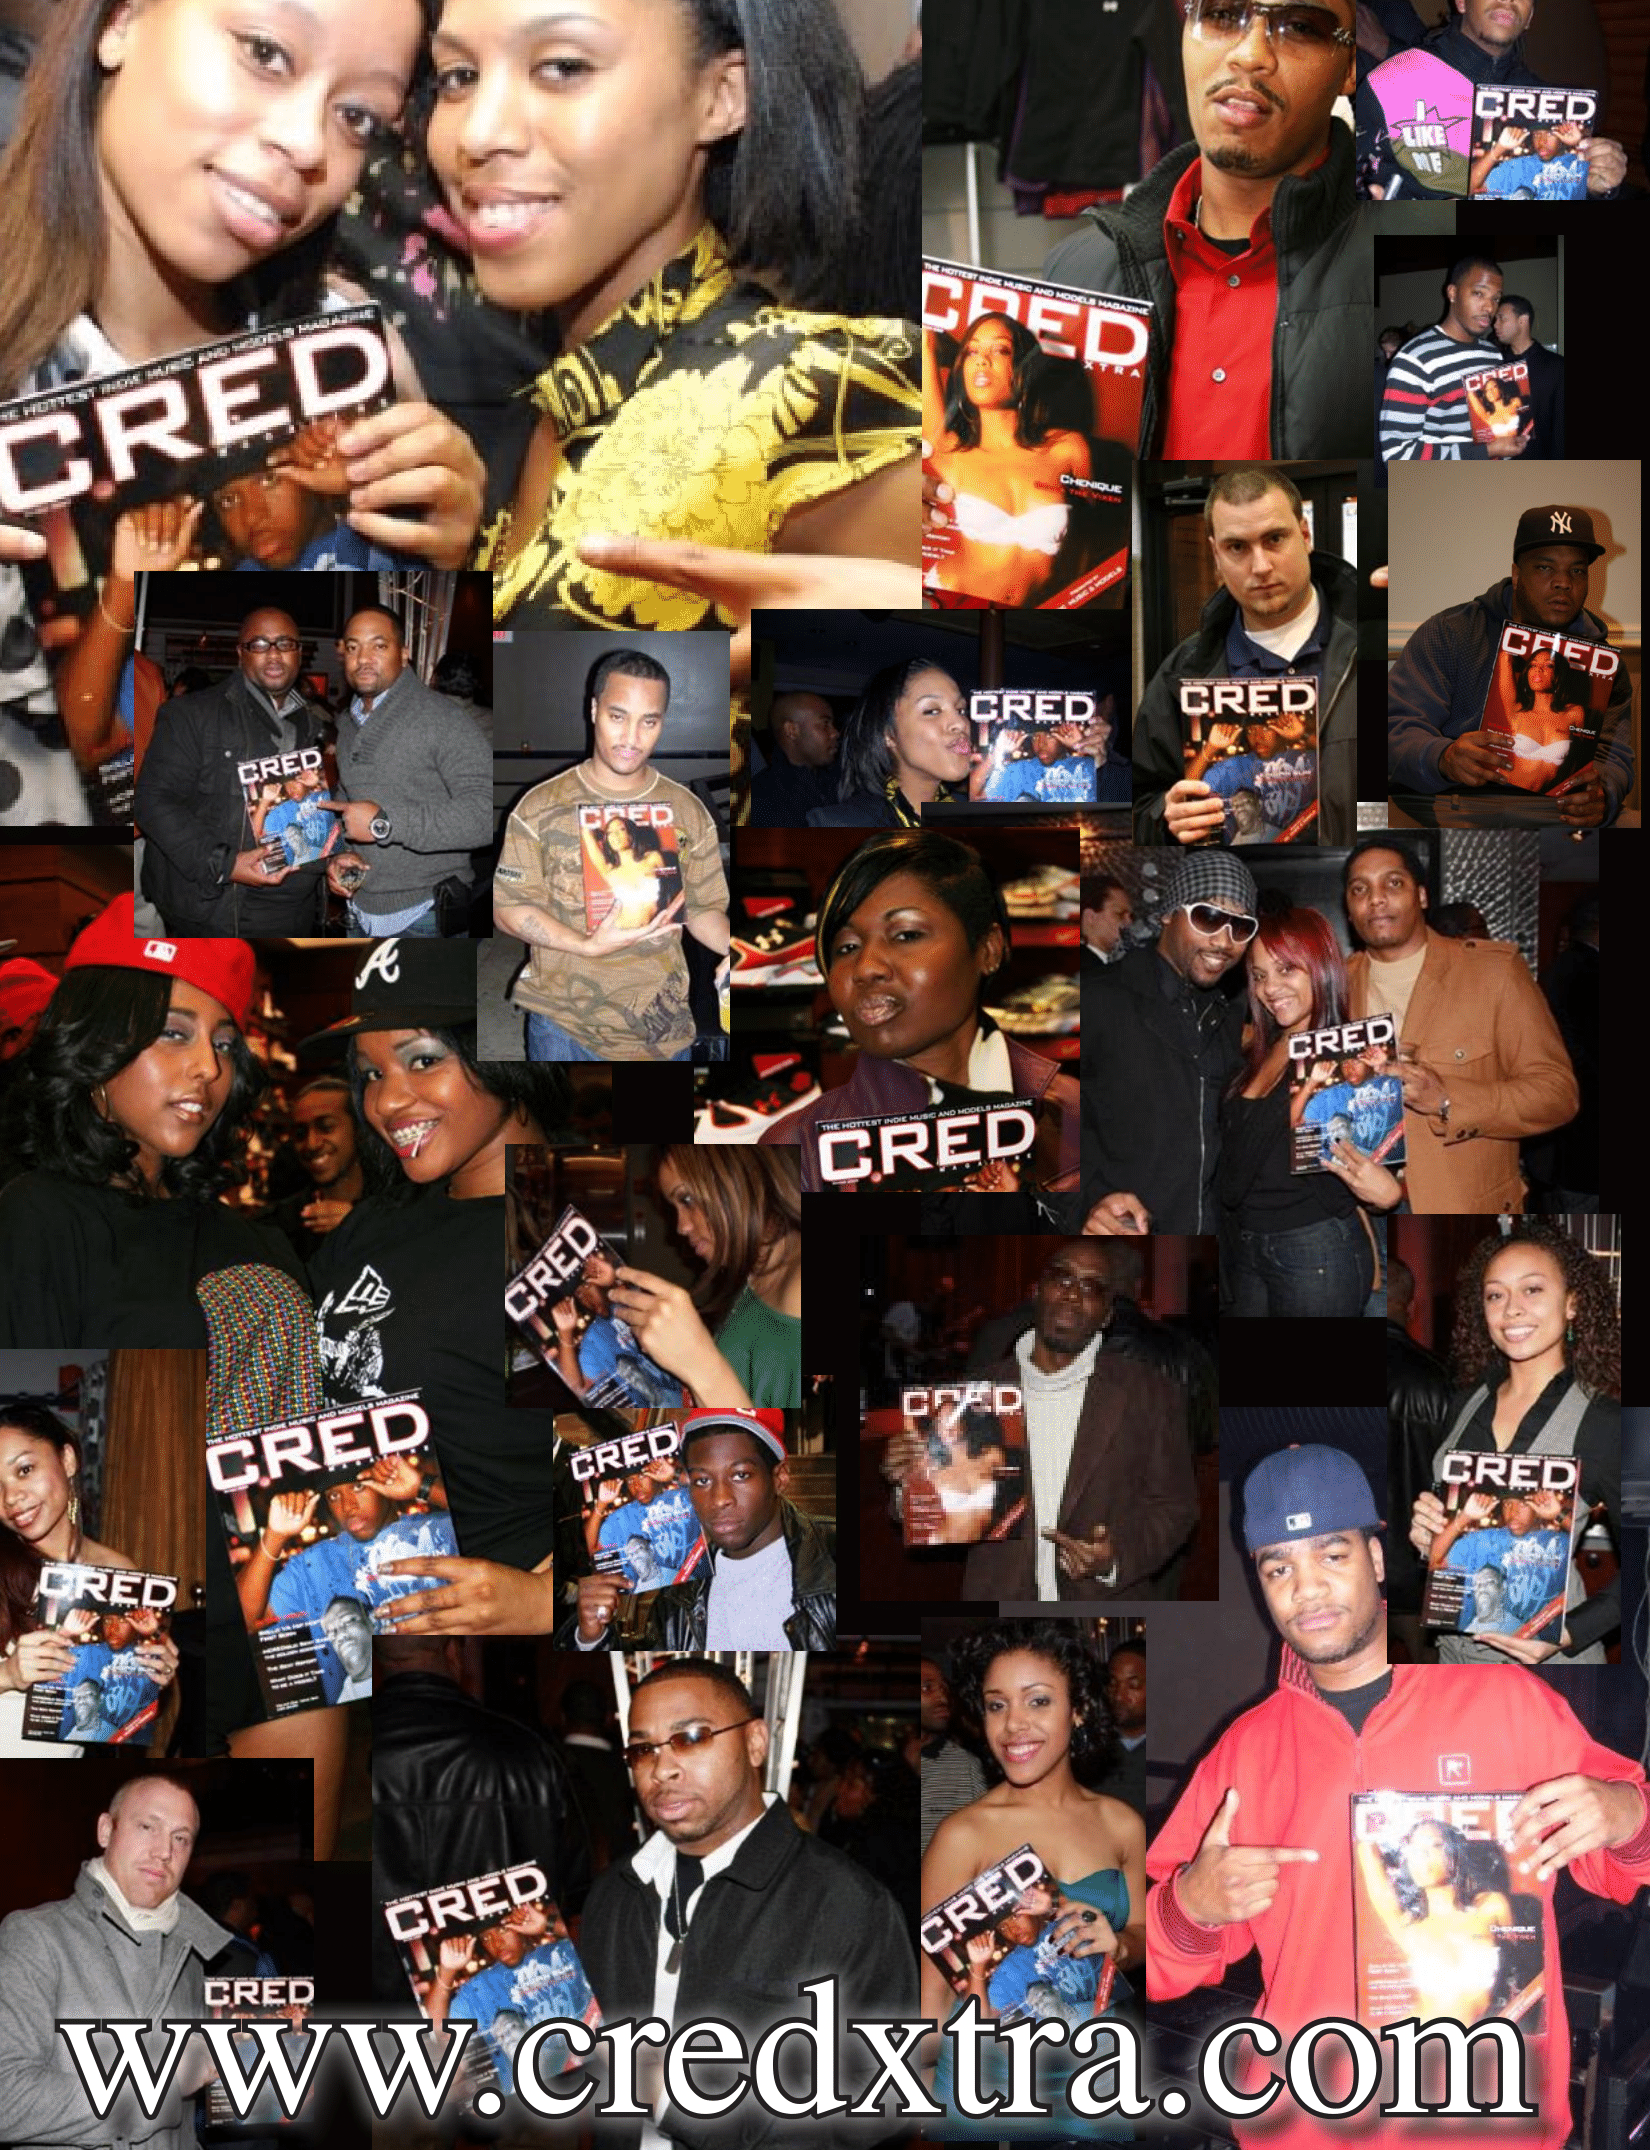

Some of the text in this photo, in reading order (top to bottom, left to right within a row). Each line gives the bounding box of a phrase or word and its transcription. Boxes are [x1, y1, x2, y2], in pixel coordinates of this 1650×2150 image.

[1416, 99, 1426, 122] I
[1475, 91, 1596, 120] CRED
[1402, 124, 1446, 148] LIKE
[924, 262, 1150, 316] THE HOTTEST INDIE MUSIC AND MODELS MAGAZINE
[1084, 361, 1142, 379] XTRA
[0, 327, 389, 512] CRED
[1060, 474, 1123, 494] CHENIQUE
[1550, 511, 1572, 534] NY
[970, 695, 1095, 721] CRED
[1180, 683, 1316, 714] CRED
[238, 750, 323, 784] CRED
[1288, 1019, 1394, 1060] CRED
[822, 1098, 1034, 1132] THE HOTTEST INDIE MUSIC AND MODELS MAGAZINE
[818, 1109, 1035, 1182] CRED
[505, 1217, 599, 1322] CRED
[206, 1392, 420, 1446] THE HOTTEST INDIE MUSIC AND MODELS MAGAZINE
[206, 1402, 430, 1491] CRED
[570, 1428, 679, 1481] CRED
[1442, 1453, 1577, 1489] CRED
[39, 1566, 177, 1608] CRED
[386, 1866, 547, 1940] CRED
[921, 1852, 1044, 1954] CRED
[204, 1981, 315, 2005] CRED
